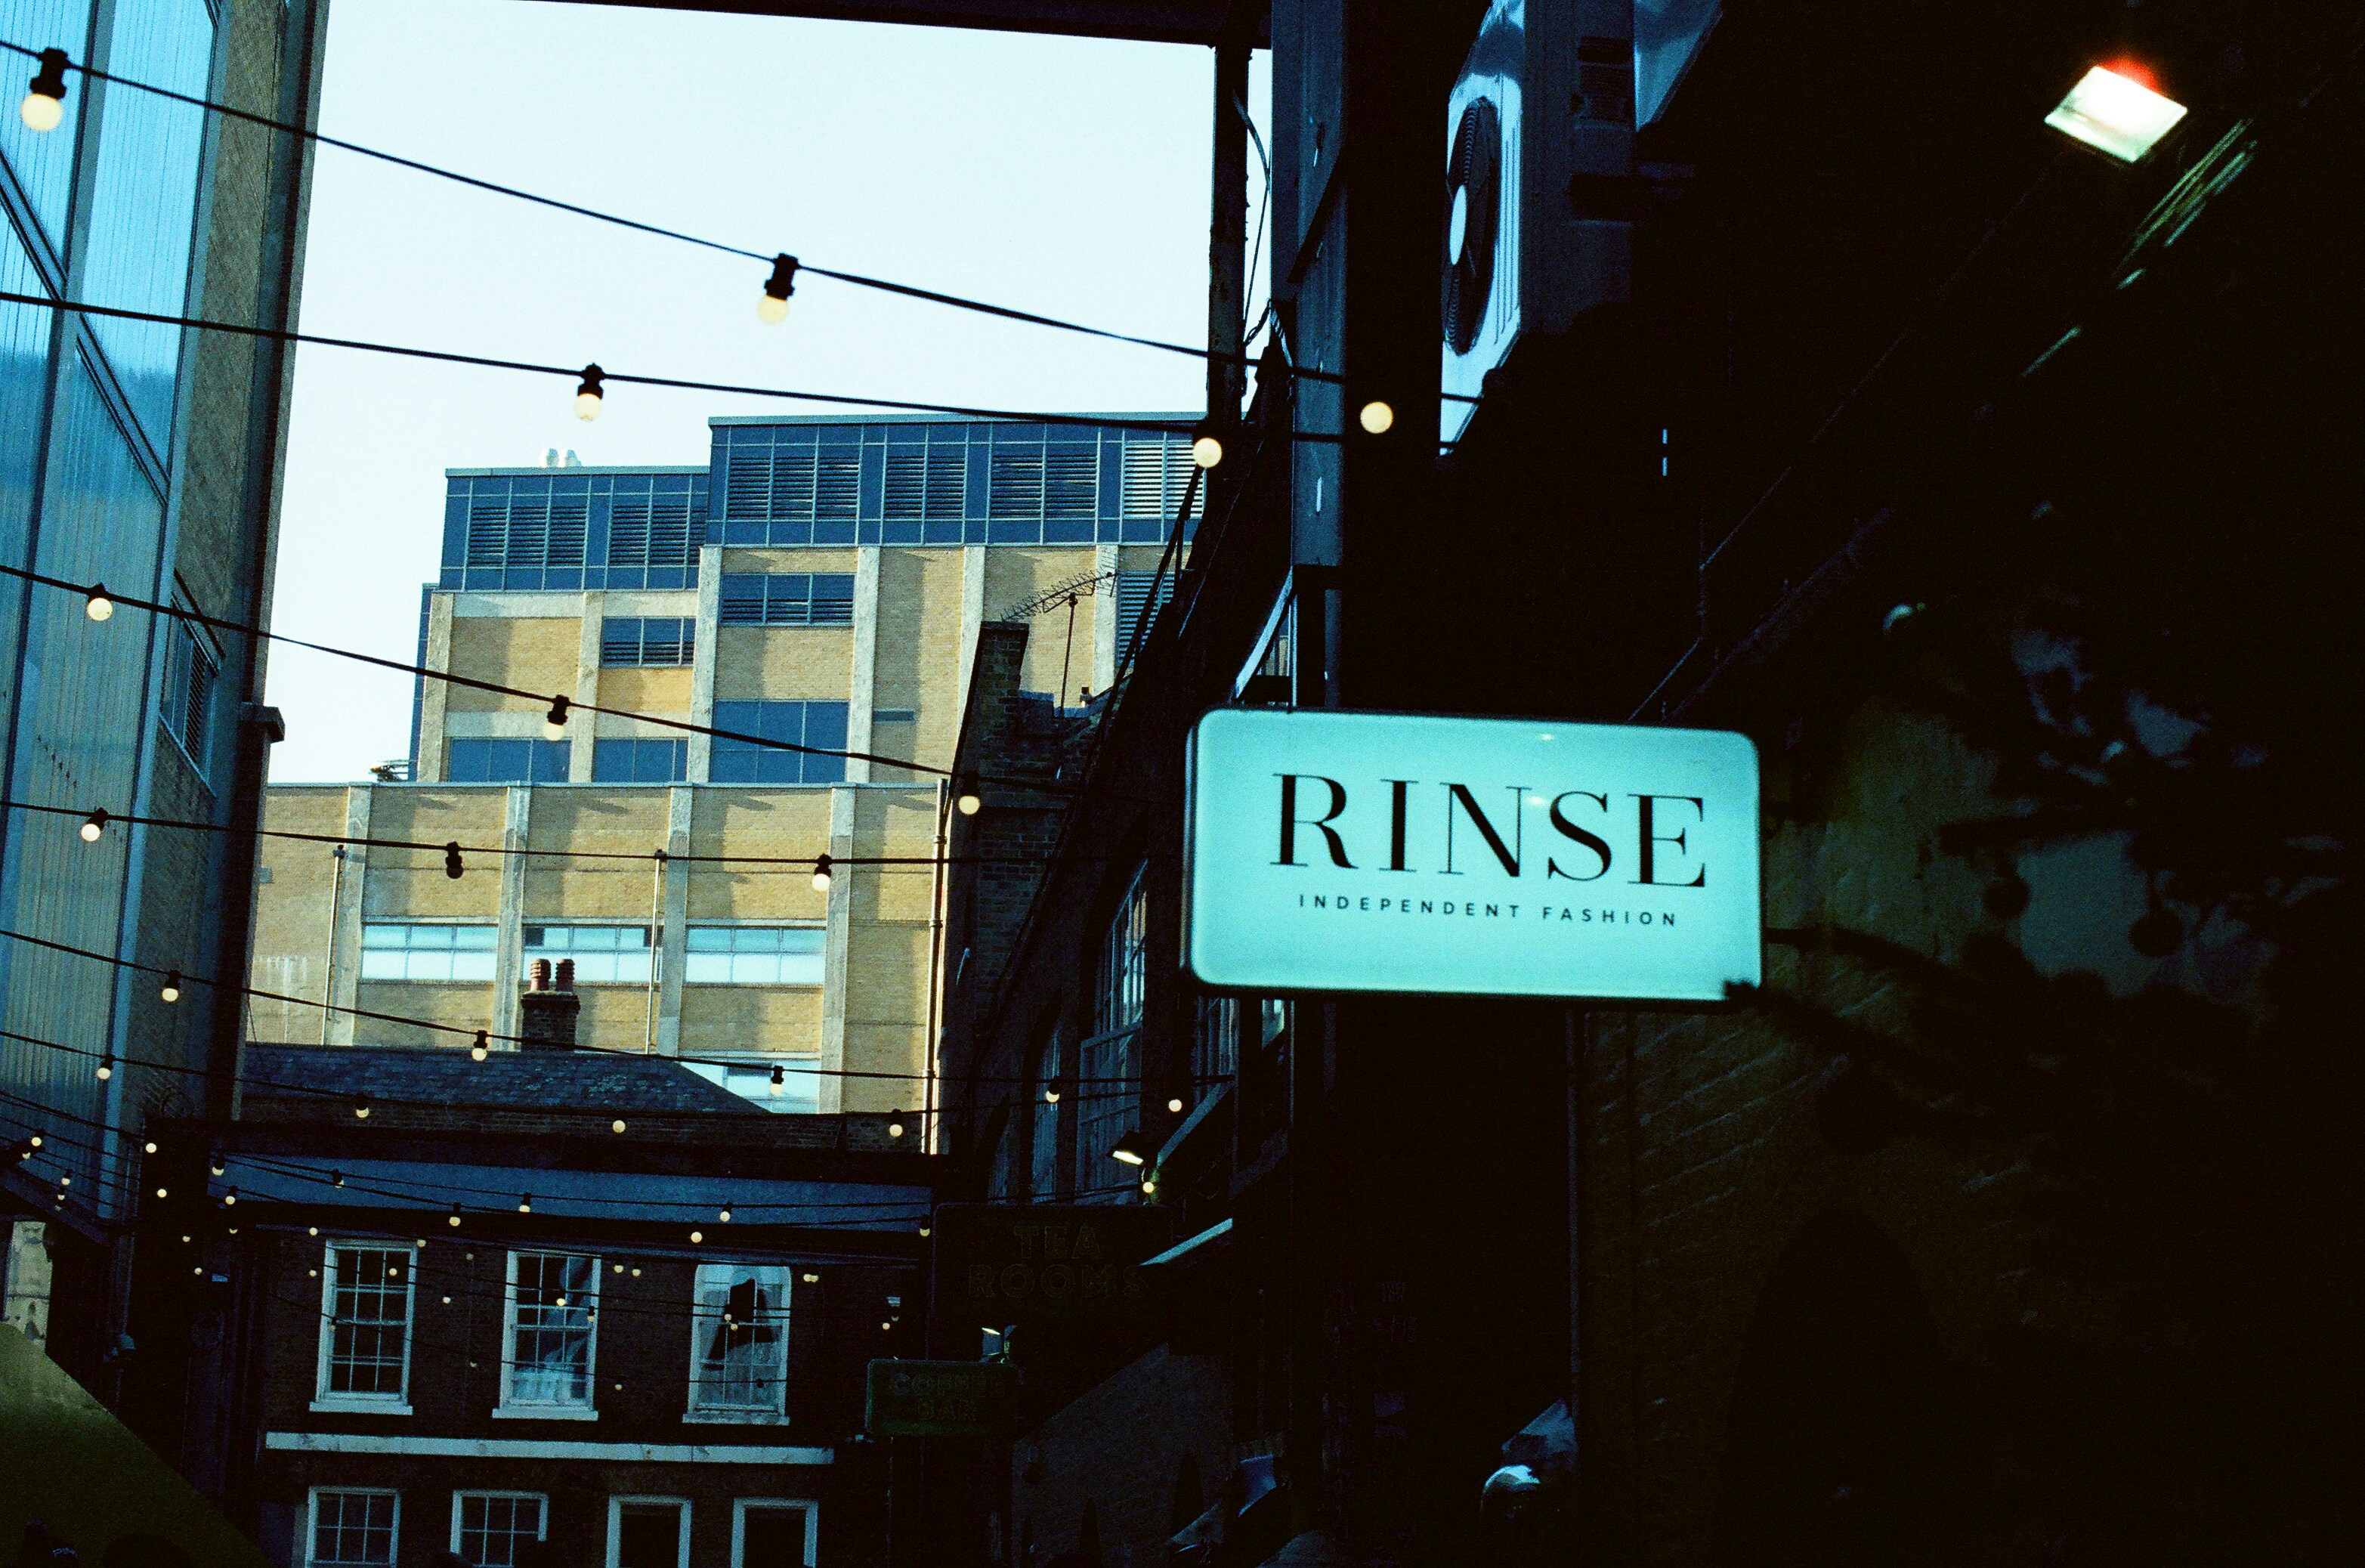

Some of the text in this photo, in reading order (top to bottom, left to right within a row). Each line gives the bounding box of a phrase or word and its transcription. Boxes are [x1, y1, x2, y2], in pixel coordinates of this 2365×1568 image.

[1269, 773, 1705, 887] RINSE
[1299, 895, 1675, 926] INDEPENDENT FASHION
[1013, 1225, 1102, 1260] TEA
[968, 1263, 1149, 1299] ROOMS
